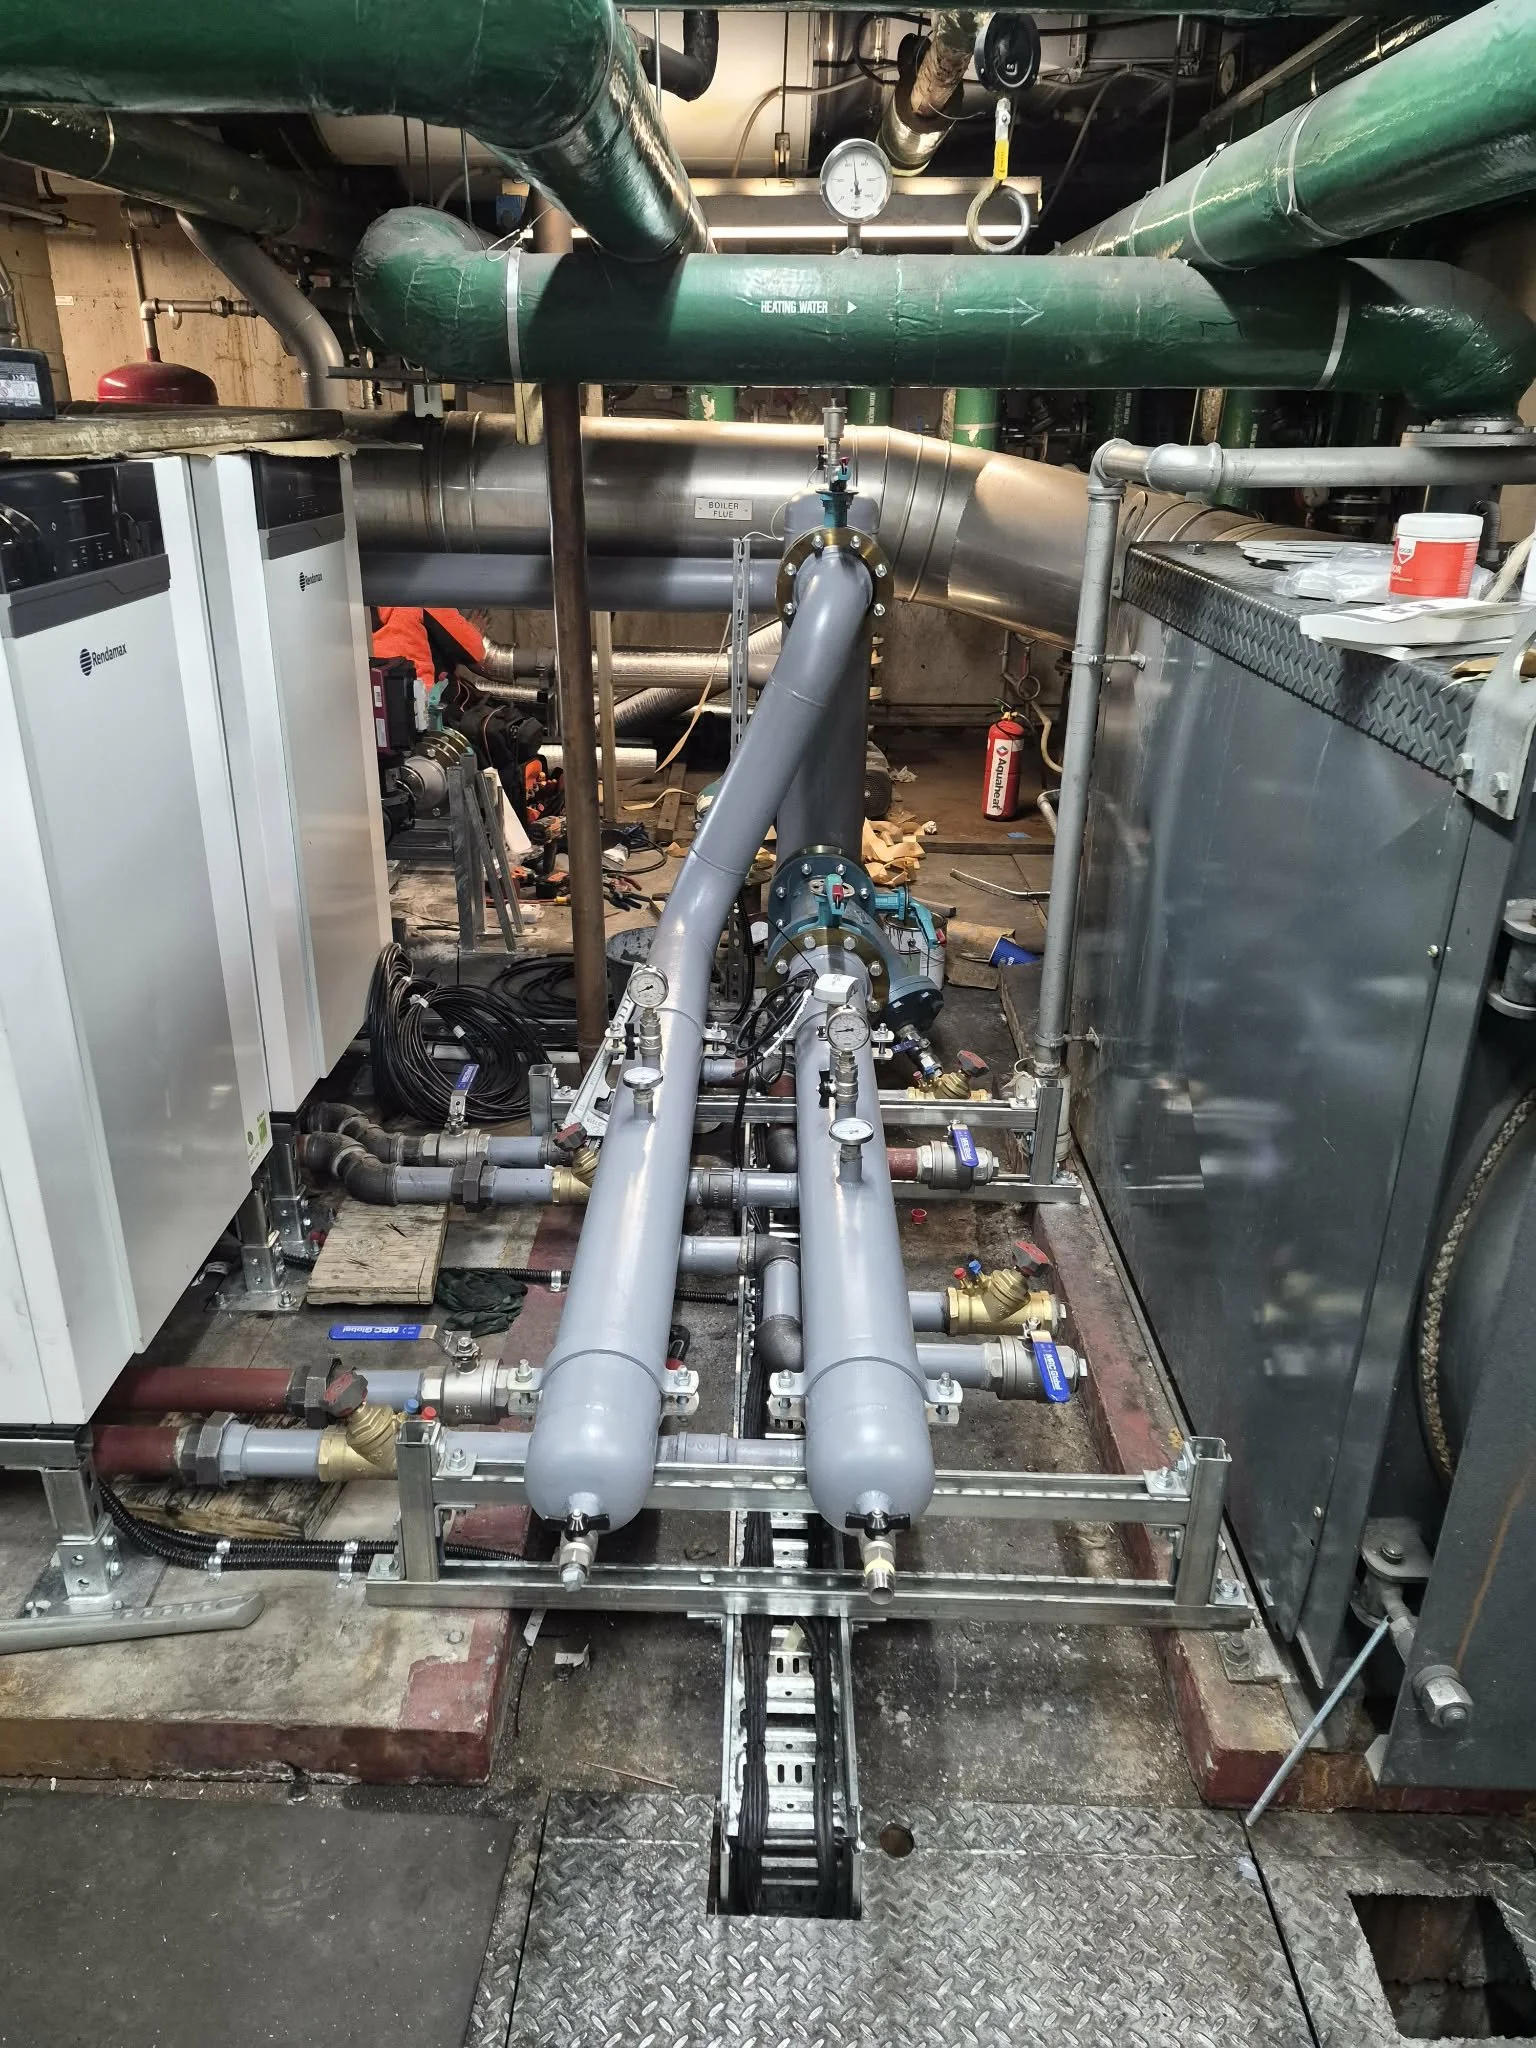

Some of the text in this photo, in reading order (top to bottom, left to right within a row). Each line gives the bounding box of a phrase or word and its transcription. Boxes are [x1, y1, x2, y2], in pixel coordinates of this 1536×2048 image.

[761, 300, 829, 313] HEATING WATER
[708, 501, 739, 510] BOILER
[713, 510, 734, 518] FLUE
[92, 643, 128, 667] Rendamax
[992, 758, 1007, 809] Aquaheat
